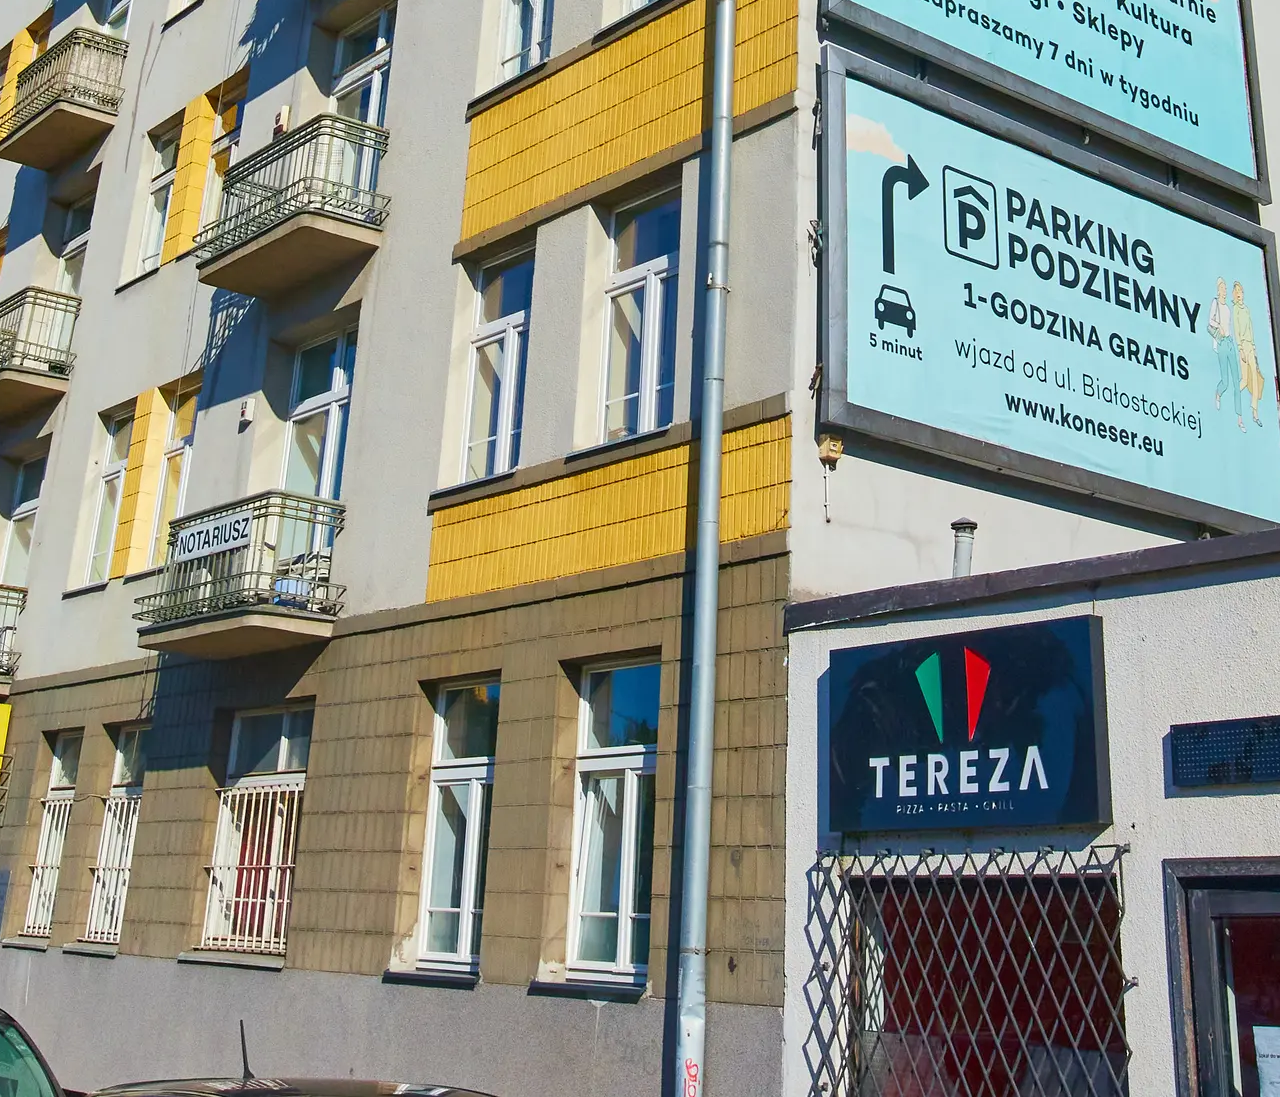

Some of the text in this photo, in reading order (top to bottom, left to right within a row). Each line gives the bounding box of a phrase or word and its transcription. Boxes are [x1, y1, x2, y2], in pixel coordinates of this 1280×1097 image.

[1073, 1, 1145, 59] Sklepy
[1048, 41, 1059, 61] 7
[1065, 50, 1094, 79] dni
[1100, 71, 1115, 87] w
[1119, 76, 1200, 127] tygodniu
[1007, 187, 1155, 276] PARKING
[1007, 232, 1202, 334] PODZIEMNY
[869, 332, 923, 362] 5 minut
[963, 282, 1190, 381] 1-GODZINA GRATIS
[954, 337, 1203, 439] wjazd od ul. Białostockiej
[1005, 393, 1165, 458] www.koneser.eu
[178, 516, 250, 557] NOTARIUSZ
[869, 745, 1049, 799] TEREZA
[896, 804, 924, 814] PIZZA
[938, 803, 969, 812] PASTA
